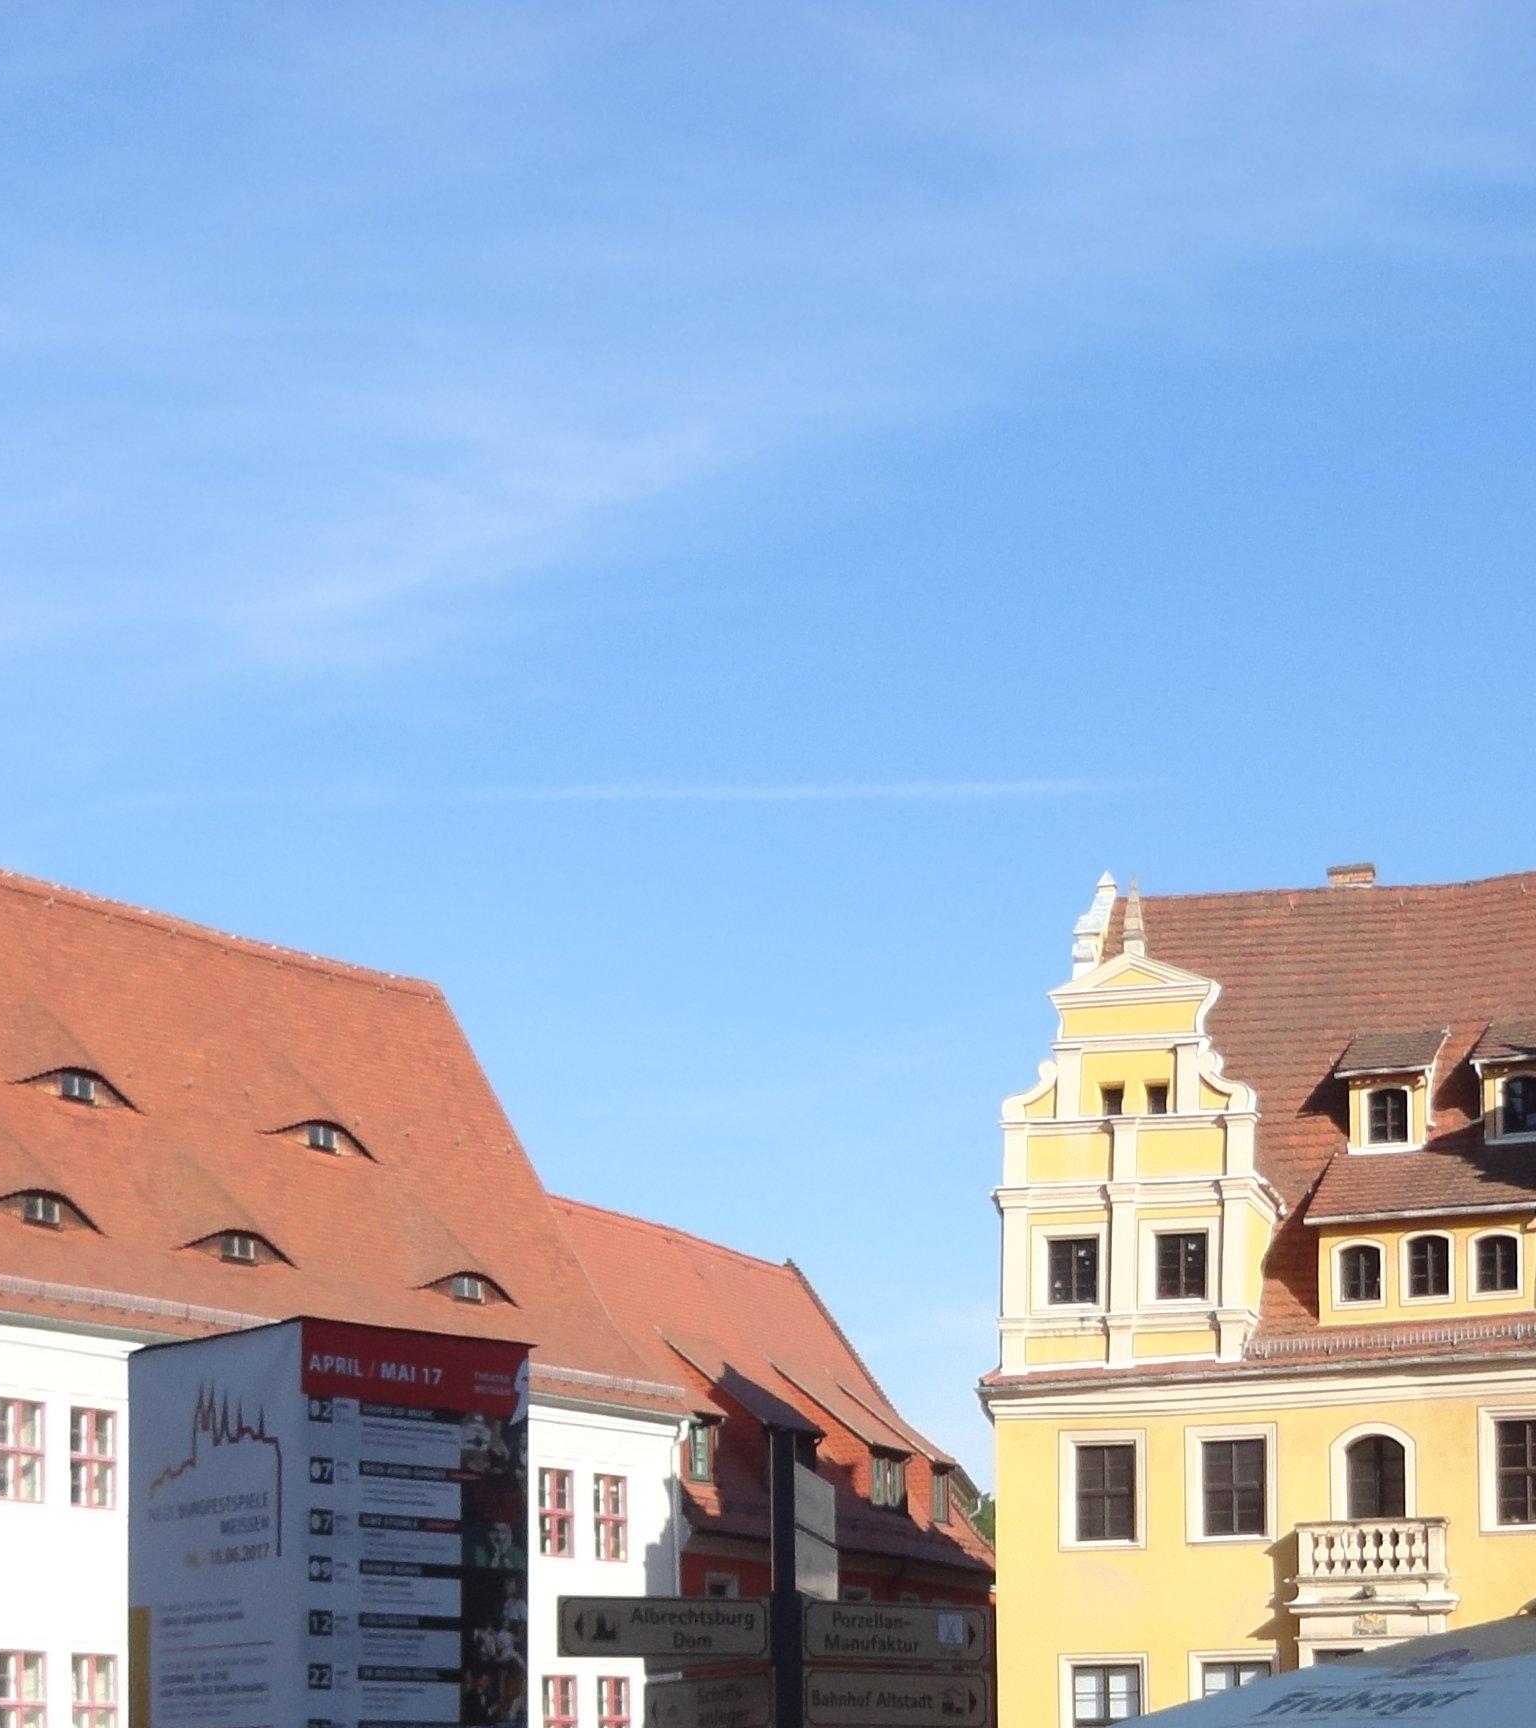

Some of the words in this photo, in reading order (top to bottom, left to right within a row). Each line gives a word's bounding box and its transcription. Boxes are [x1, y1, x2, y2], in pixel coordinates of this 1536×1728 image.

[310, 1354, 363, 1376] APRIL
[380, 1362, 416, 1384] MAI
[422, 1367, 443, 1386] 17
[630, 1607, 755, 1630] Albrechtsburg
[831, 1611, 911, 1629] Porzellan-
[672, 1631, 713, 1649] Dom
[824, 1633, 920, 1653] Manufaktur
[811, 1690, 872, 1707] Bahnhof
[875, 1691, 933, 1709] Altstadt
[1250, 1689, 1481, 1717] Freiberger
